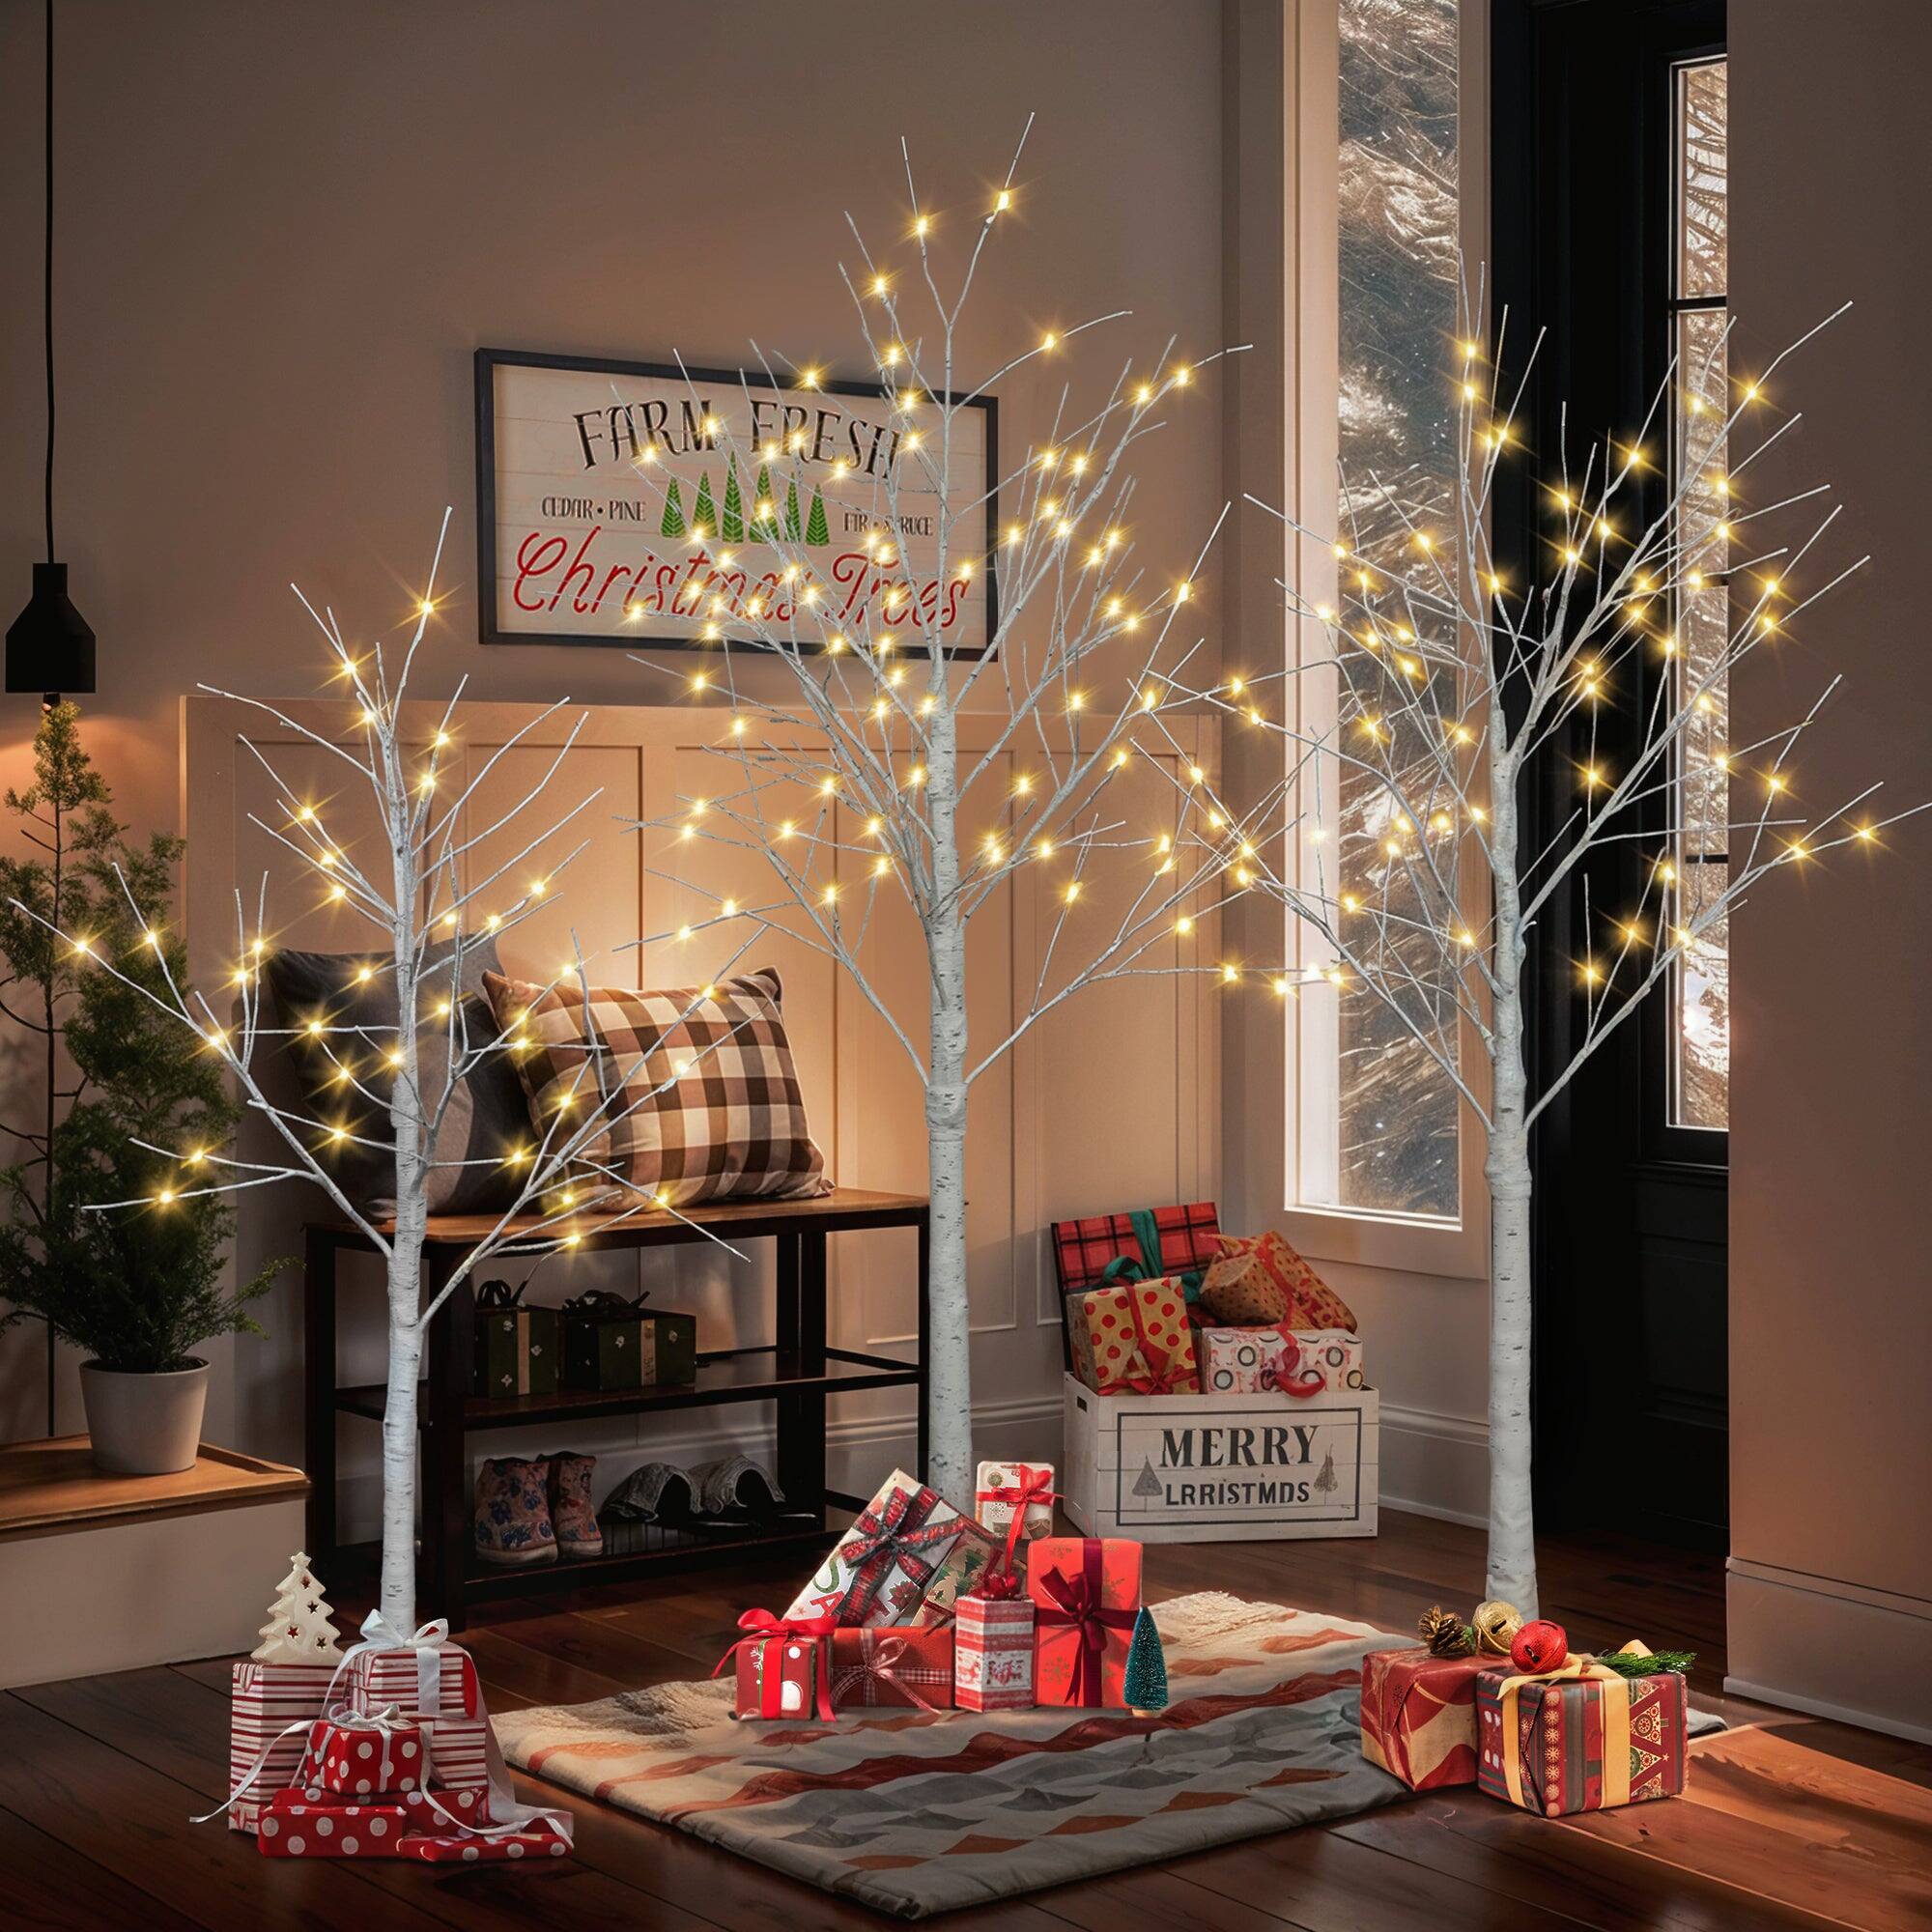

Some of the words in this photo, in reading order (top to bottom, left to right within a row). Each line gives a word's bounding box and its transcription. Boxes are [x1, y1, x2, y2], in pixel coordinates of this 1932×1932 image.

[572, 399, 716, 470] FARM
[750, 399, 902, 479] FRESH
[542, 497, 593, 521] CEDAR
[609, 500, 646, 522] PINE
[883, 515, 934, 536] SRUCE
[1161, 1425, 1320, 1467] MERRY
